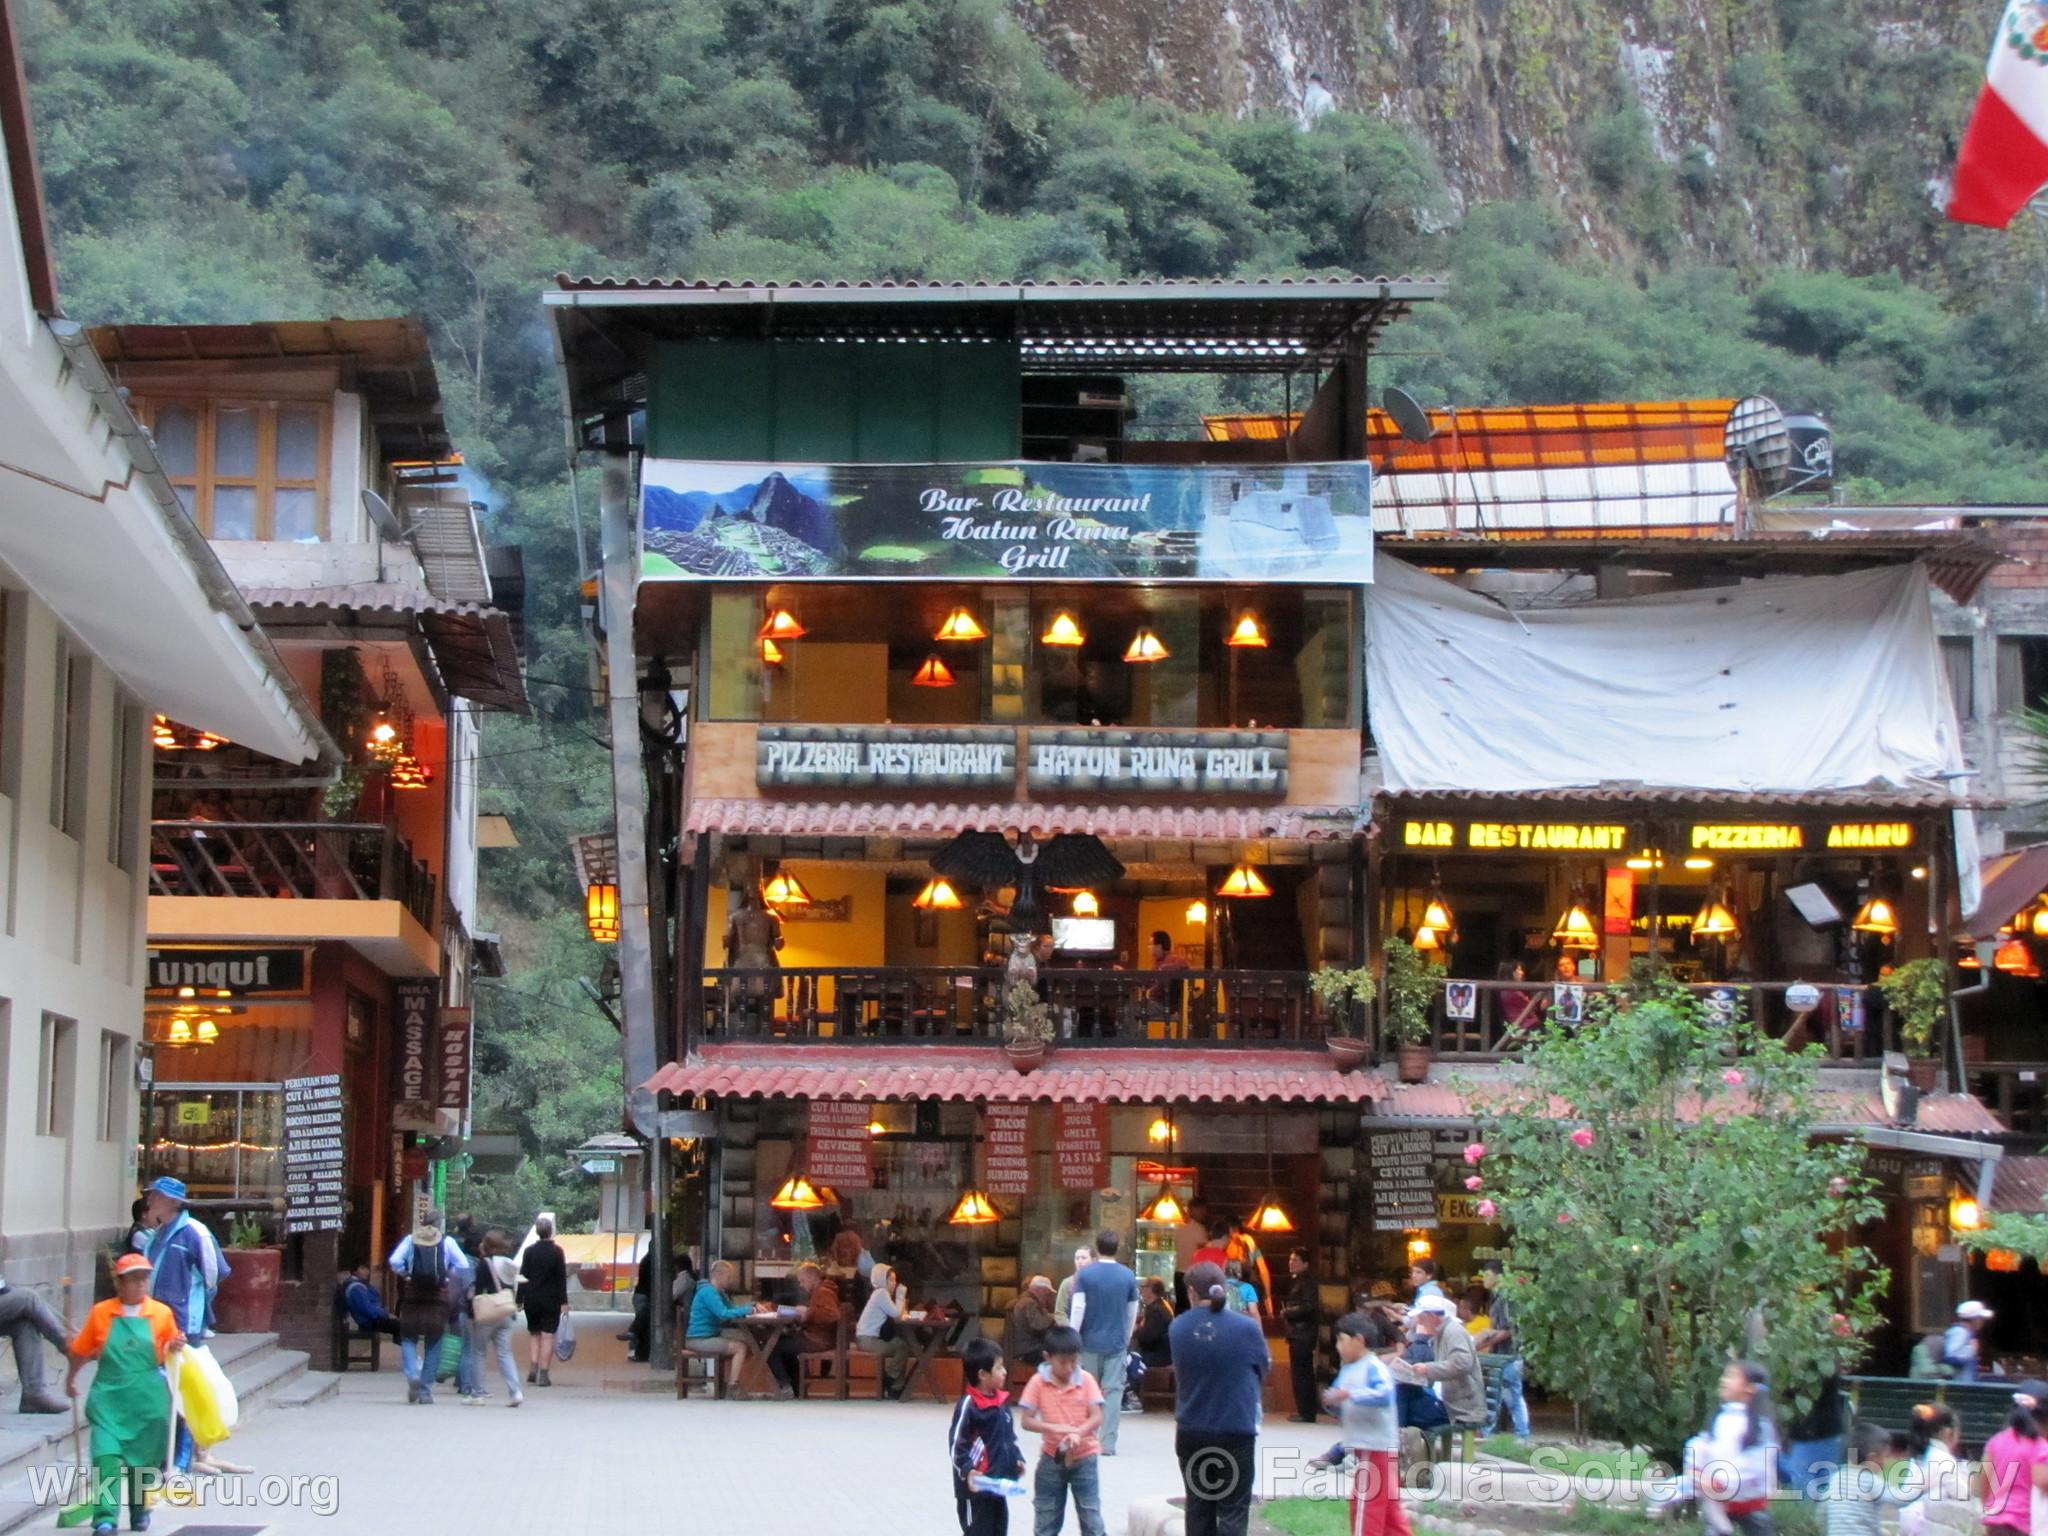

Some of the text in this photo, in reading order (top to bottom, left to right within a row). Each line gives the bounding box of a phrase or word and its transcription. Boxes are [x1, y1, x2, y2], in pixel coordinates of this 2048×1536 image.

[992, 488, 1152, 512] Restaurant
[941, 517, 1131, 541] Hatun Runa
[998, 545, 1070, 574] Grill
[767, 742, 1006, 775] PIZZERIA RESTAURANT
[1037, 745, 1277, 779] HATUN RUNA GRILL
[1405, 821, 1626, 849] BAR RESTAURANT
[1692, 825, 1802, 849] PIZZERIA
[398, 985, 431, 995] INKA
[404, 996, 426, 1100] MASSAGE
[443, 1030, 466, 1105] HOSTAL
[285, 1074, 340, 1090] PERUVIAN FOOD
[286, 1086, 342, 1102] CUY AL HORNO
[994, 1118, 1027, 1129] TACOS
[990, 1131, 1025, 1142] CHILES
[1063, 1128, 1097, 1139] OMELET
[817, 1140, 862, 1152] CEVICHE
[1371, 1141, 1432, 1156] CUY AL HORNO
[313, 1152, 321, 1162] AL
[1059, 1152, 1102, 1163] PASTAS
[1380, 1166, 1427, 1178] CEVICHE
[1062, 1177, 1094, 1188] VINOS
[1399, 1191, 1433, 1202] GALLINA
[290, 1218, 343, 1233] SOPA INKA
